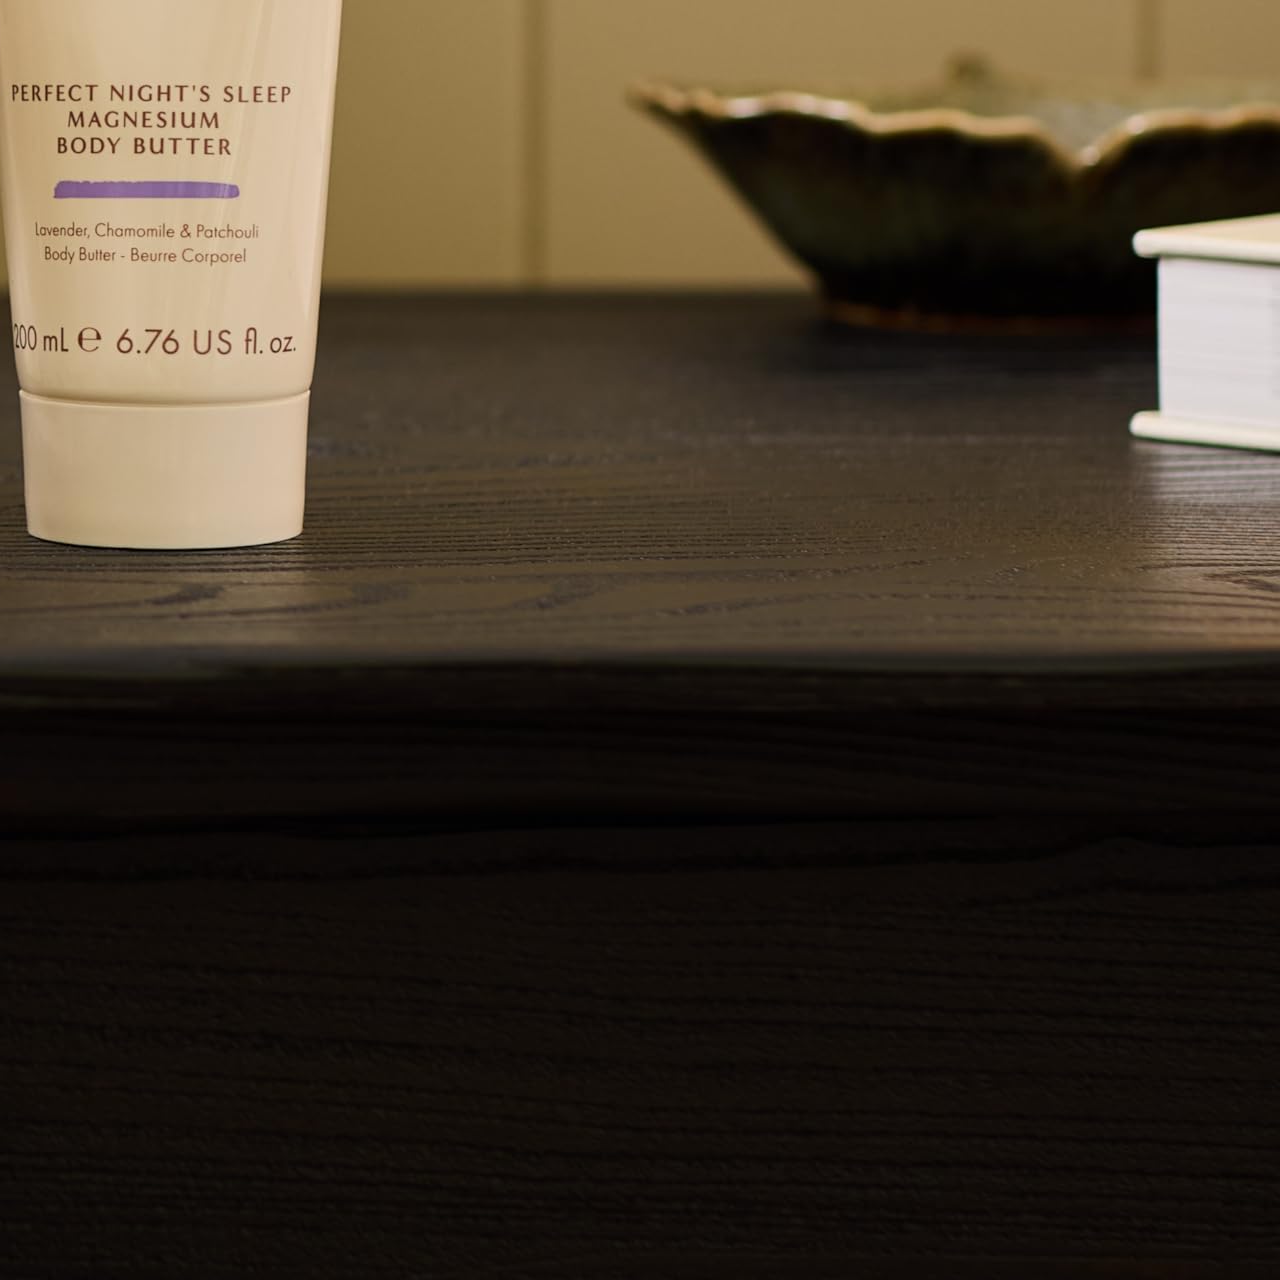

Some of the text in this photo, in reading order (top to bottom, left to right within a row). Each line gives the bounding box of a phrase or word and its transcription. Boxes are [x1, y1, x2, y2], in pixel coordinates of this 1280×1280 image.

[11, 84, 292, 104] PERFECT NIGHT'S SLEEP
[67, 111, 220, 129] MAGNESIUM
[56, 137, 231, 155] BODY BUTTER
[34, 221, 259, 239] Lavender, Chamomile & Patchouli
[44, 245, 75, 264] Body
[78, 246, 116, 261] Butter
[130, 247, 177, 262] Beurre
[181, 247, 246, 267] Corporel
[13, 323, 37, 351] 200
[42, 326, 69, 352] mL
[116, 328, 180, 355] 6.76
[193, 329, 232, 355] US
[244, 327, 264, 355] fl.
[269, 336, 297, 354] oz.
